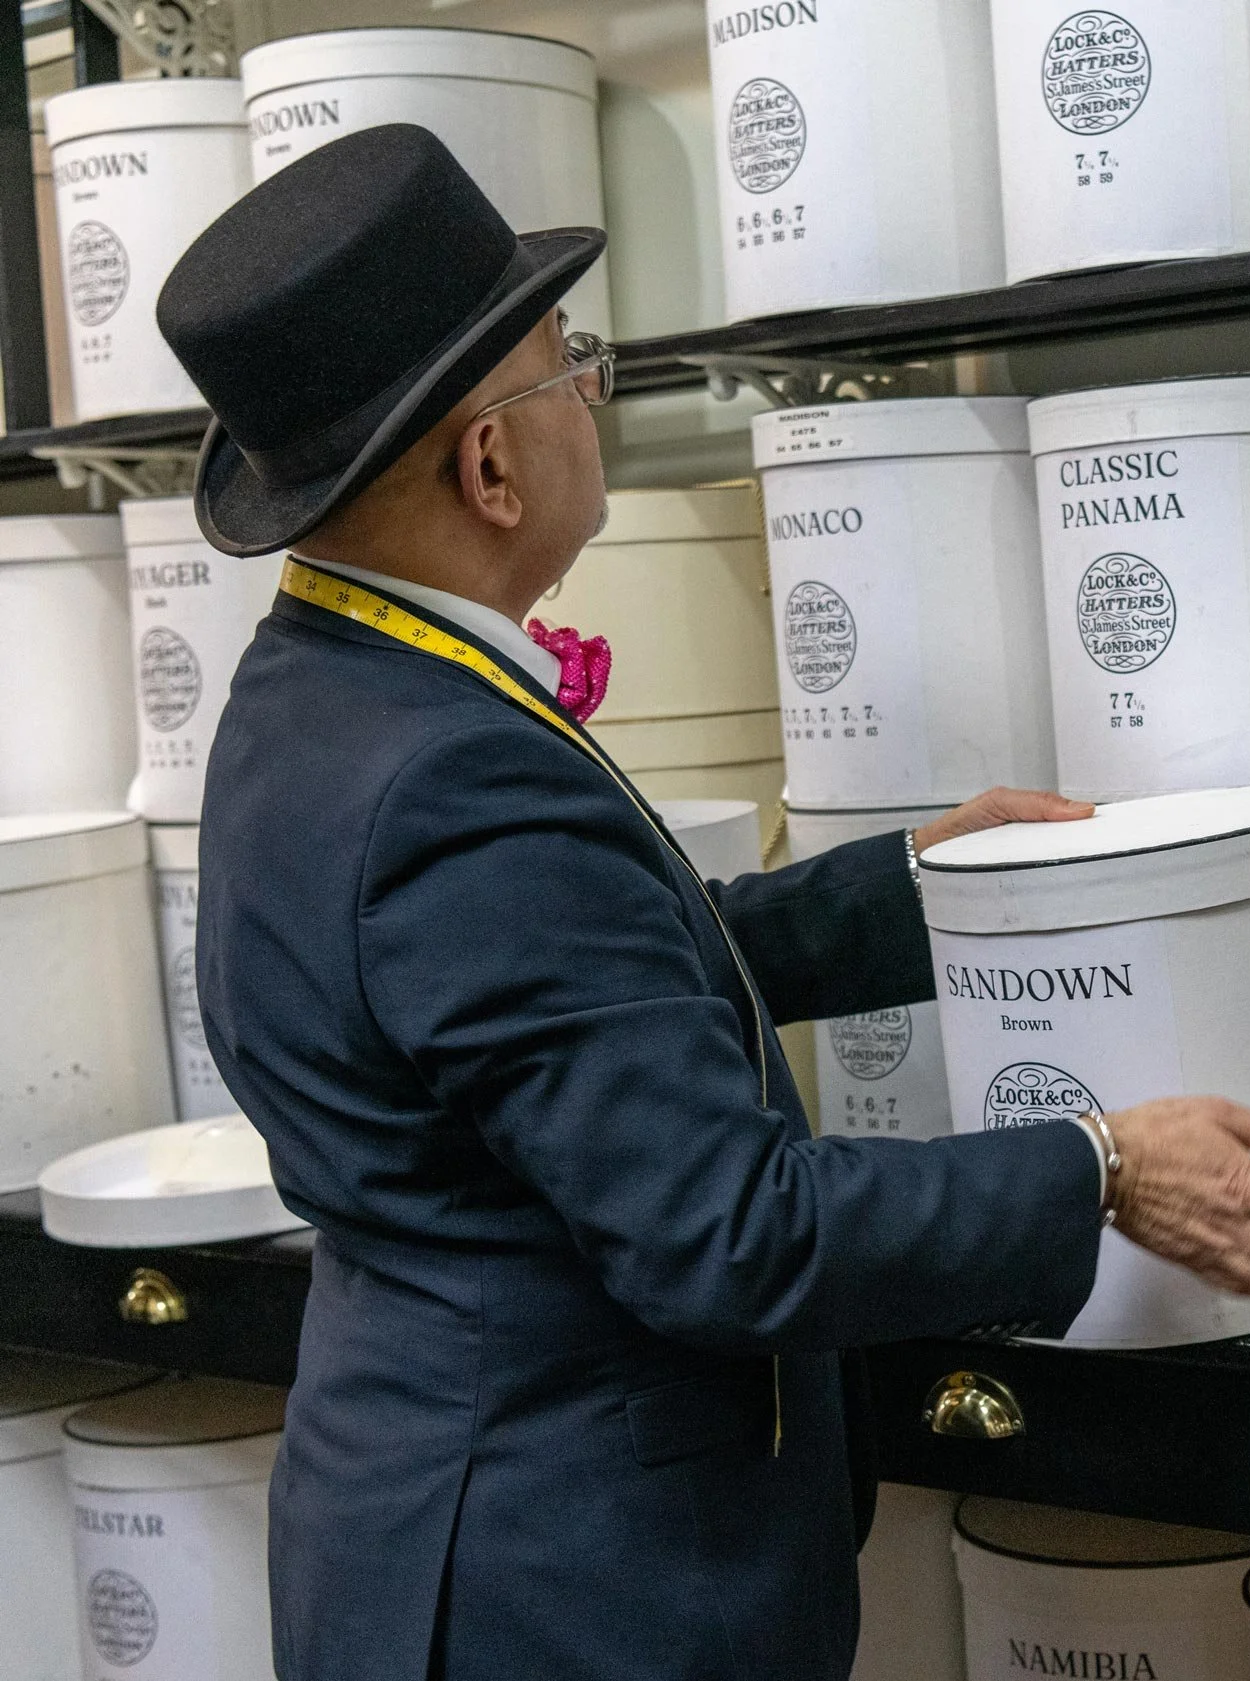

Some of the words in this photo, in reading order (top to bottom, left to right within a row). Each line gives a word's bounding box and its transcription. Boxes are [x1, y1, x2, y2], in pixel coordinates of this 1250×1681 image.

[713, 0, 818, 47] MADISON
[1051, 51, 1140, 76] HATTERS
[1103, 73, 1146, 90] Street
[1059, 97, 1131, 119] LONDON
[740, 159, 791, 178] LONDON
[1078, 175, 1091, 187] 58
[1100, 172, 1114, 184] 59
[794, 205, 805, 222] 7
[1060, 450, 1179, 487] CLASSIC
[1062, 493, 1186, 529] PANAMA
[771, 506, 863, 541] MONACO
[1084, 594, 1166, 614] HATTERS
[336, 591, 350, 604] 35
[373, 608, 389, 621] 36
[412, 628, 428, 640] 37
[451, 646, 467, 657] 38
[1132, 615, 1172, 631] Street
[1093, 639, 1158, 655] LONDON
[795, 661, 843, 675] LONDON
[1110, 693, 1119, 710] 7
[1110, 716, 1122, 729] 57
[1129, 715, 1144, 728] 58
[946, 963, 1134, 1002] SANDOWN
[1001, 1015, 1054, 1031] Brown
[840, 1045, 895, 1062] LONDON
[1009, 1638, 1157, 1681] NAMIBIA
